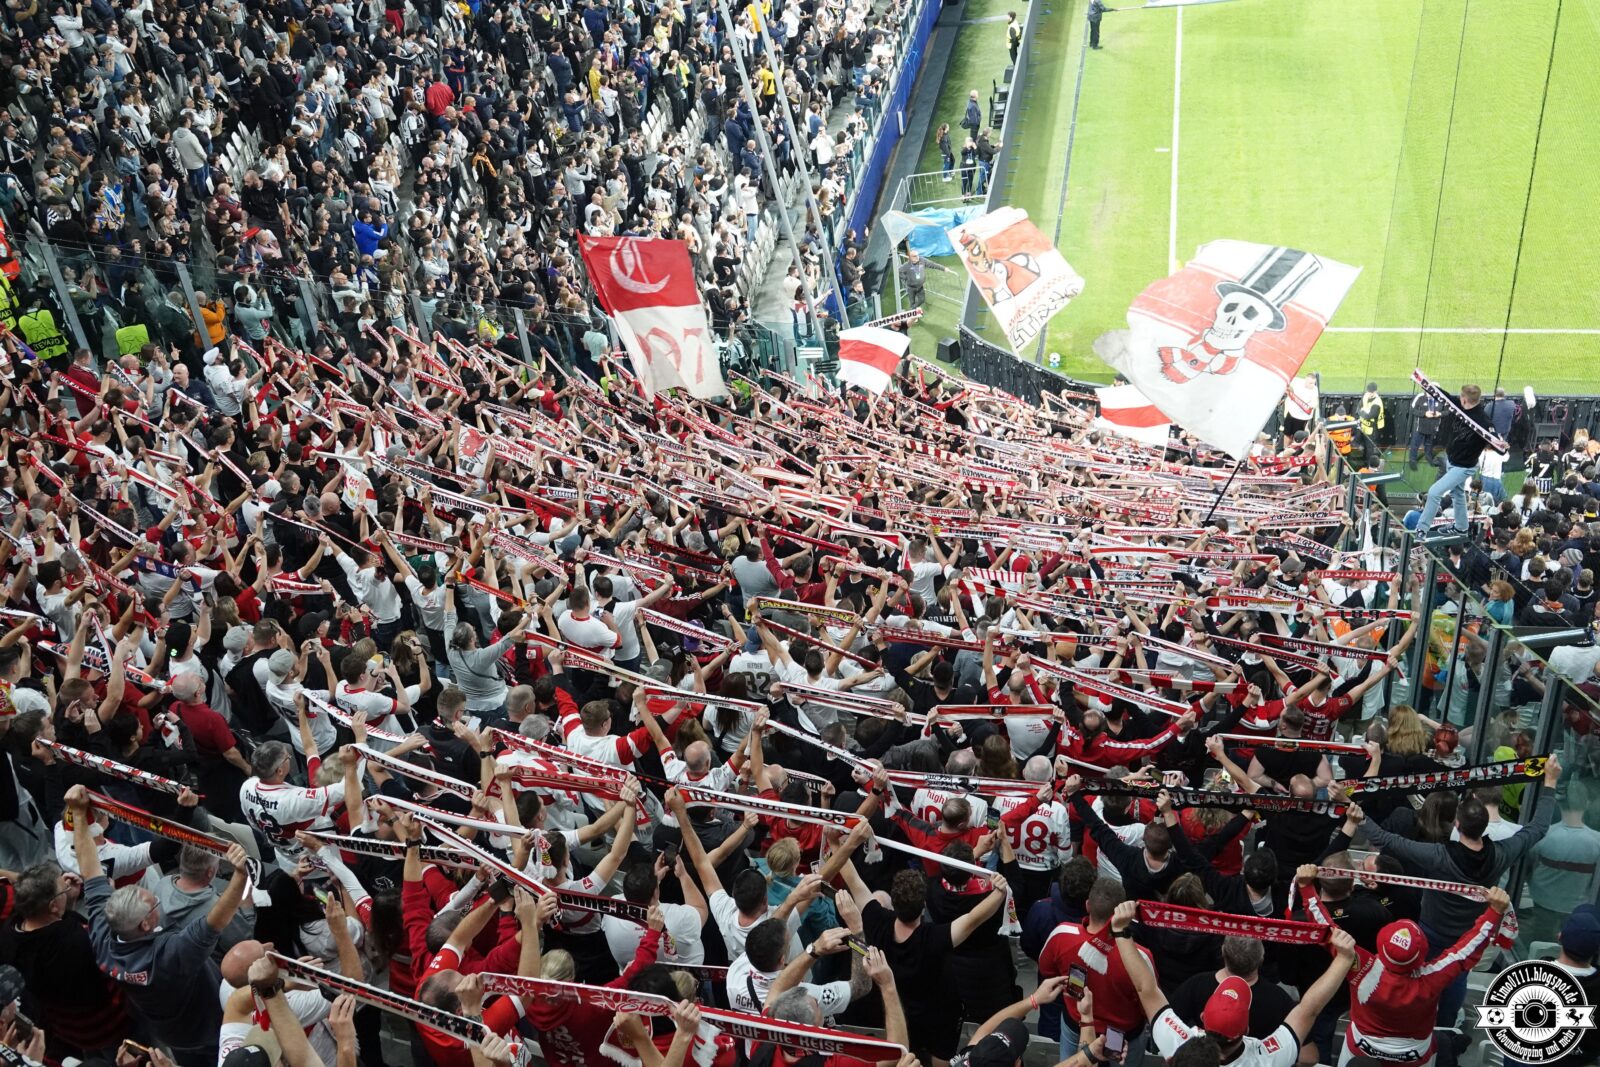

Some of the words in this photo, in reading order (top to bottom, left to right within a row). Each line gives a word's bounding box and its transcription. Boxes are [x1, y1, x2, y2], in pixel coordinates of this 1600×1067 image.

[1539, 462, 1550, 478] 7
[1144, 908, 1188, 923] VfB
[1198, 915, 1321, 941] Stuttgart
[799, 1035, 845, 1053] REISE
